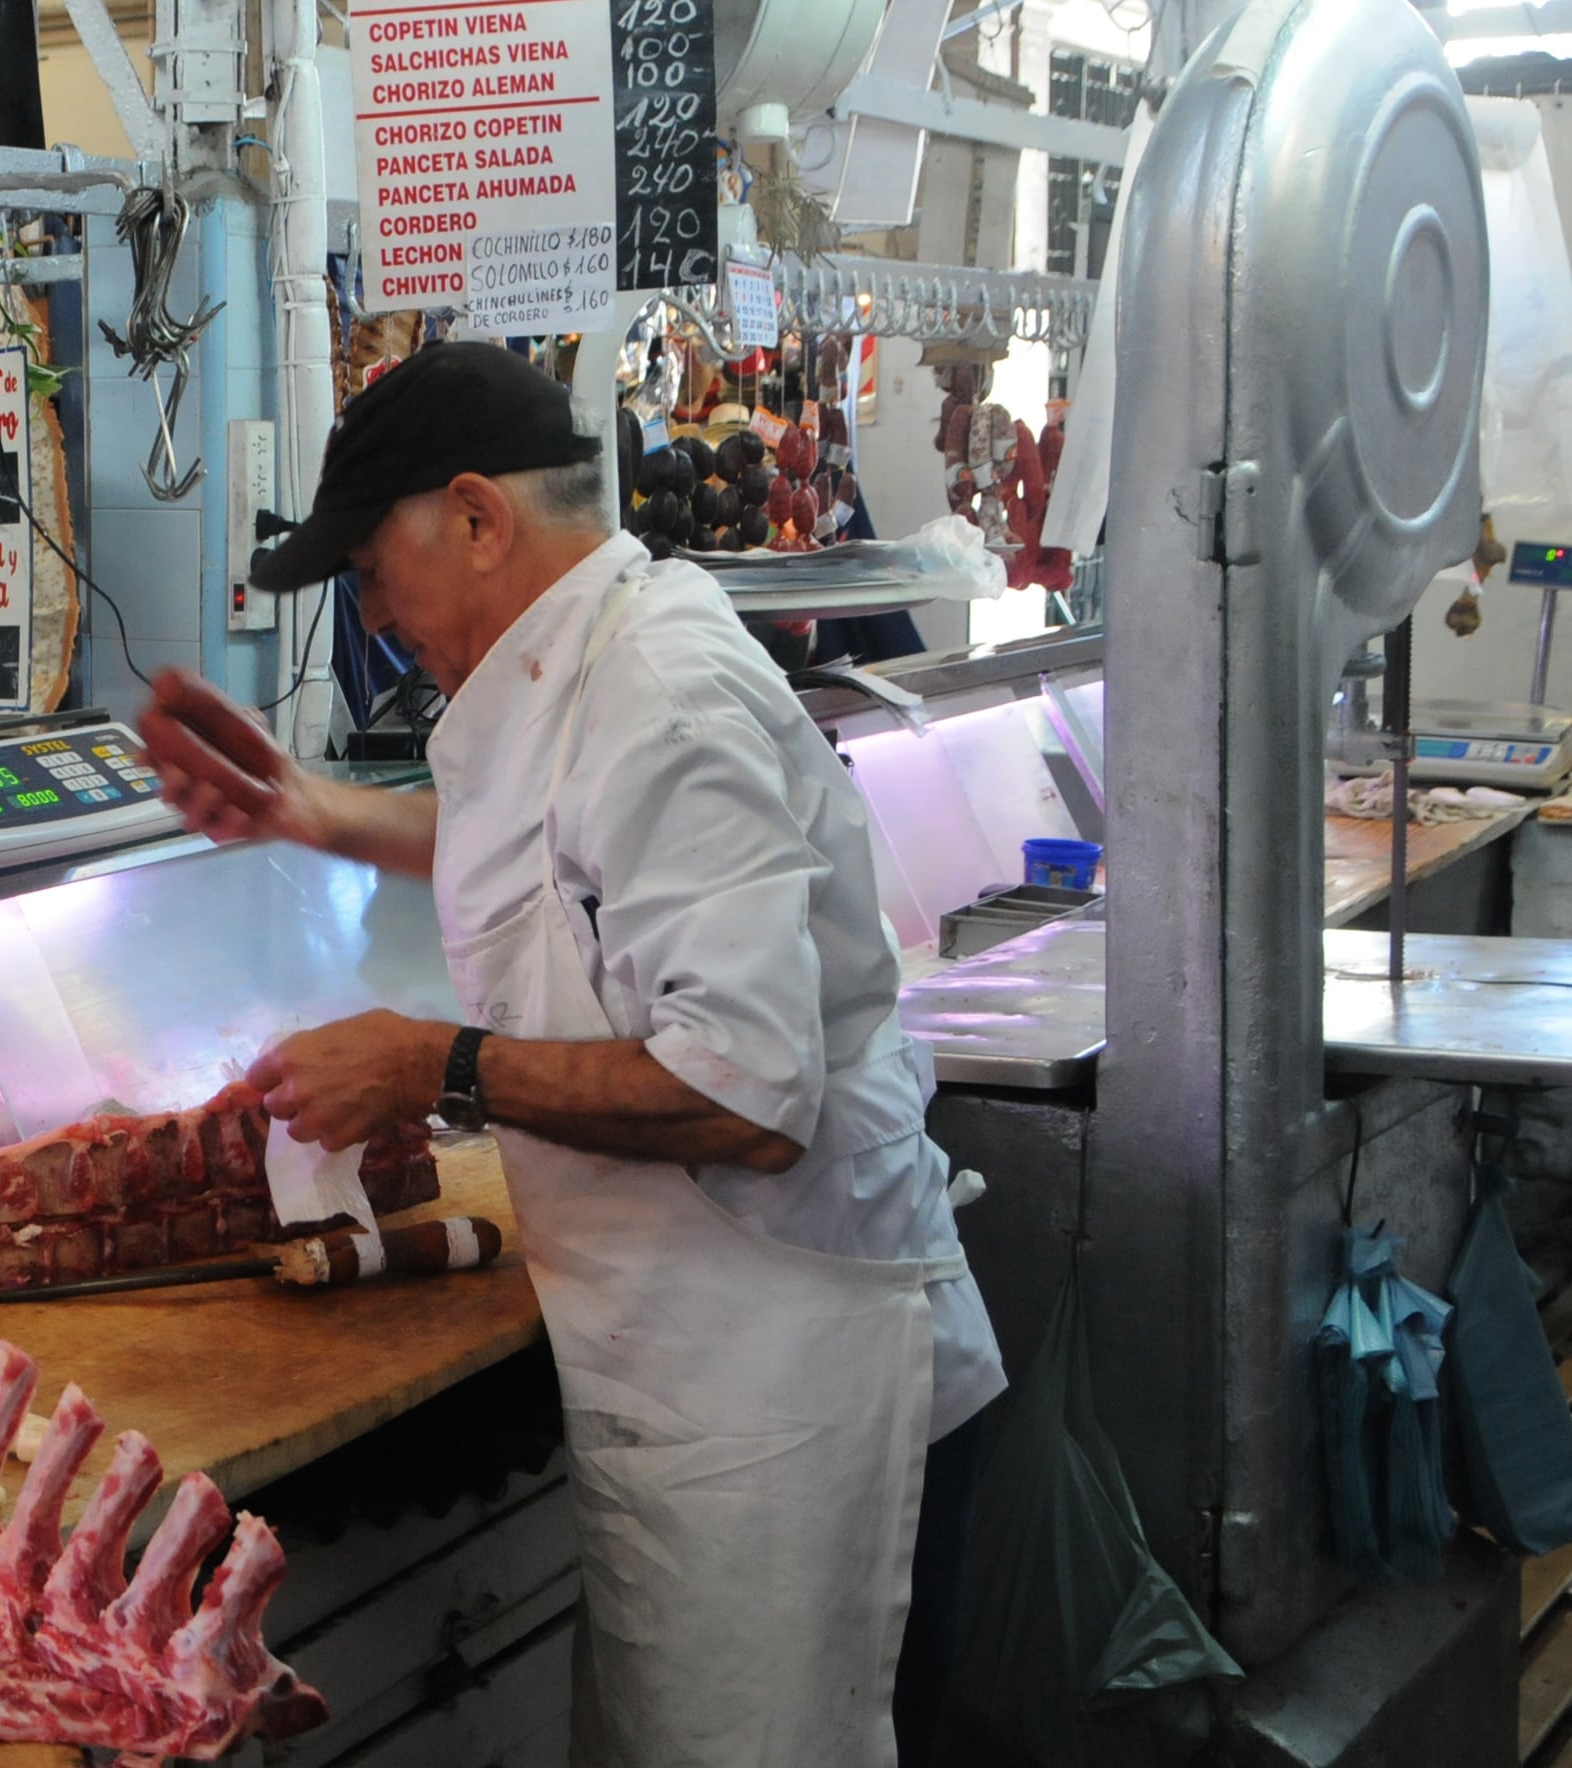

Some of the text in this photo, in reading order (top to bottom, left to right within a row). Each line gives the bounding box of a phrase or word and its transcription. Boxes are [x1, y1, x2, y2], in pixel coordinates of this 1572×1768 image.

[369, 12, 527, 43] COPETIN VIENA
[371, 40, 569, 74] SALCHICHAS VIENA
[372, 72, 555, 105] CHORIZO ALEMAN
[375, 113, 563, 146] CHORIZO COPETIN
[377, 145, 553, 176] PANCETA SALADA
[379, 173, 577, 207] PANCETA AHUMADA
[380, 211, 477, 237] CORDERO
[619, 206, 700, 249] 120
[381, 243, 463, 266] LECHON
[382, 273, 464, 297] CHIVITO
[473, 308, 549, 329] DE CORDERO
[5, 369, 17, 392] de
[9, 550, 18, 576] y
[21, 740, 71, 756] SYSTEL
